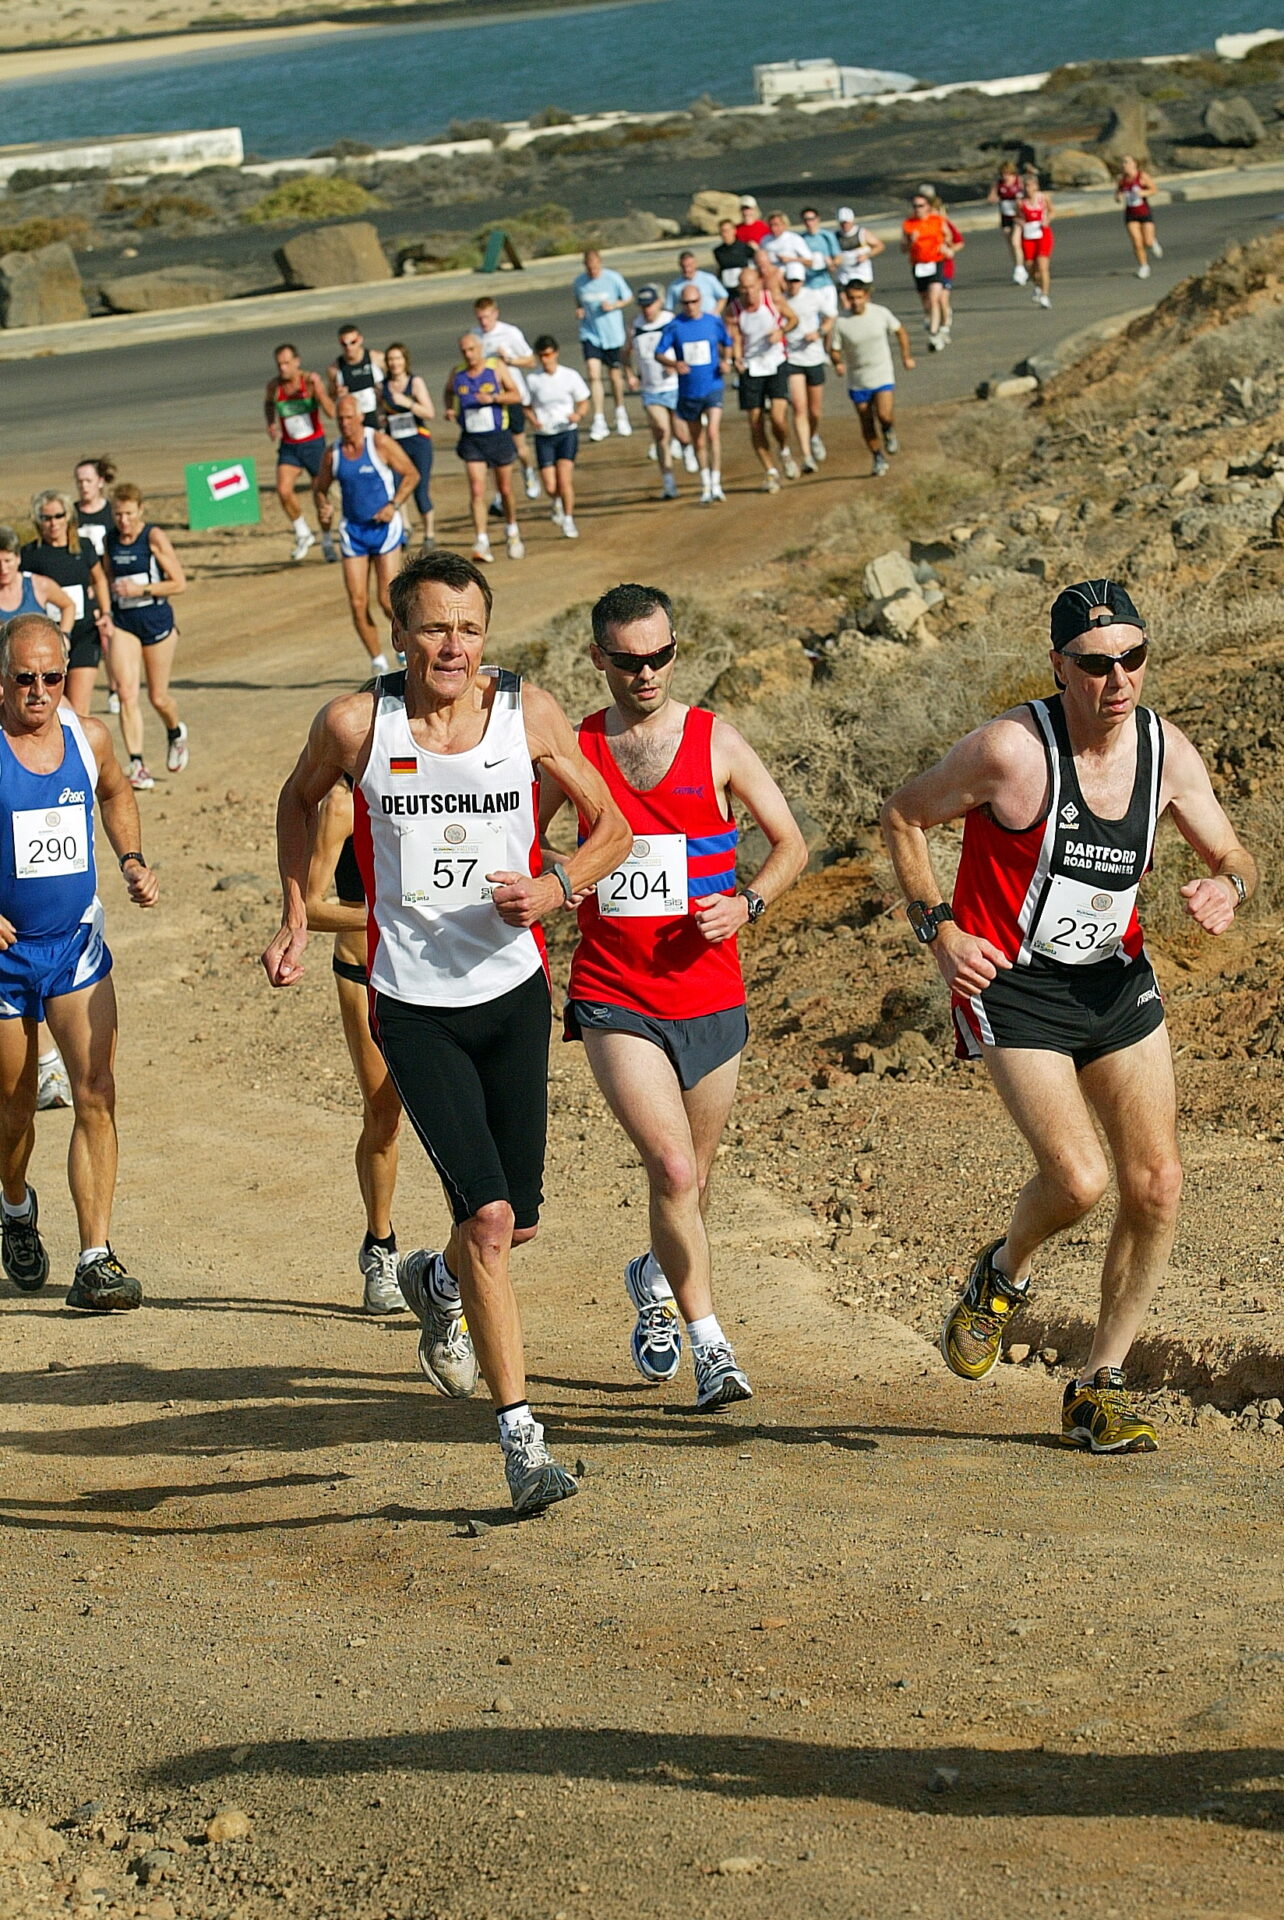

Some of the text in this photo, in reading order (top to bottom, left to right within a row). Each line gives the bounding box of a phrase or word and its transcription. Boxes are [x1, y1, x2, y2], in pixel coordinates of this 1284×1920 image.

[381, 791, 520, 815] DEUTSCHLAND
[28, 836, 77, 864] 290
[1065, 840, 1137, 864] DARTFORD
[433, 859, 479, 889] 57
[1063, 855, 1134, 875] ROAD RUNNERS
[610, 871, 671, 901] 204
[1050, 917, 1117, 950] 232
